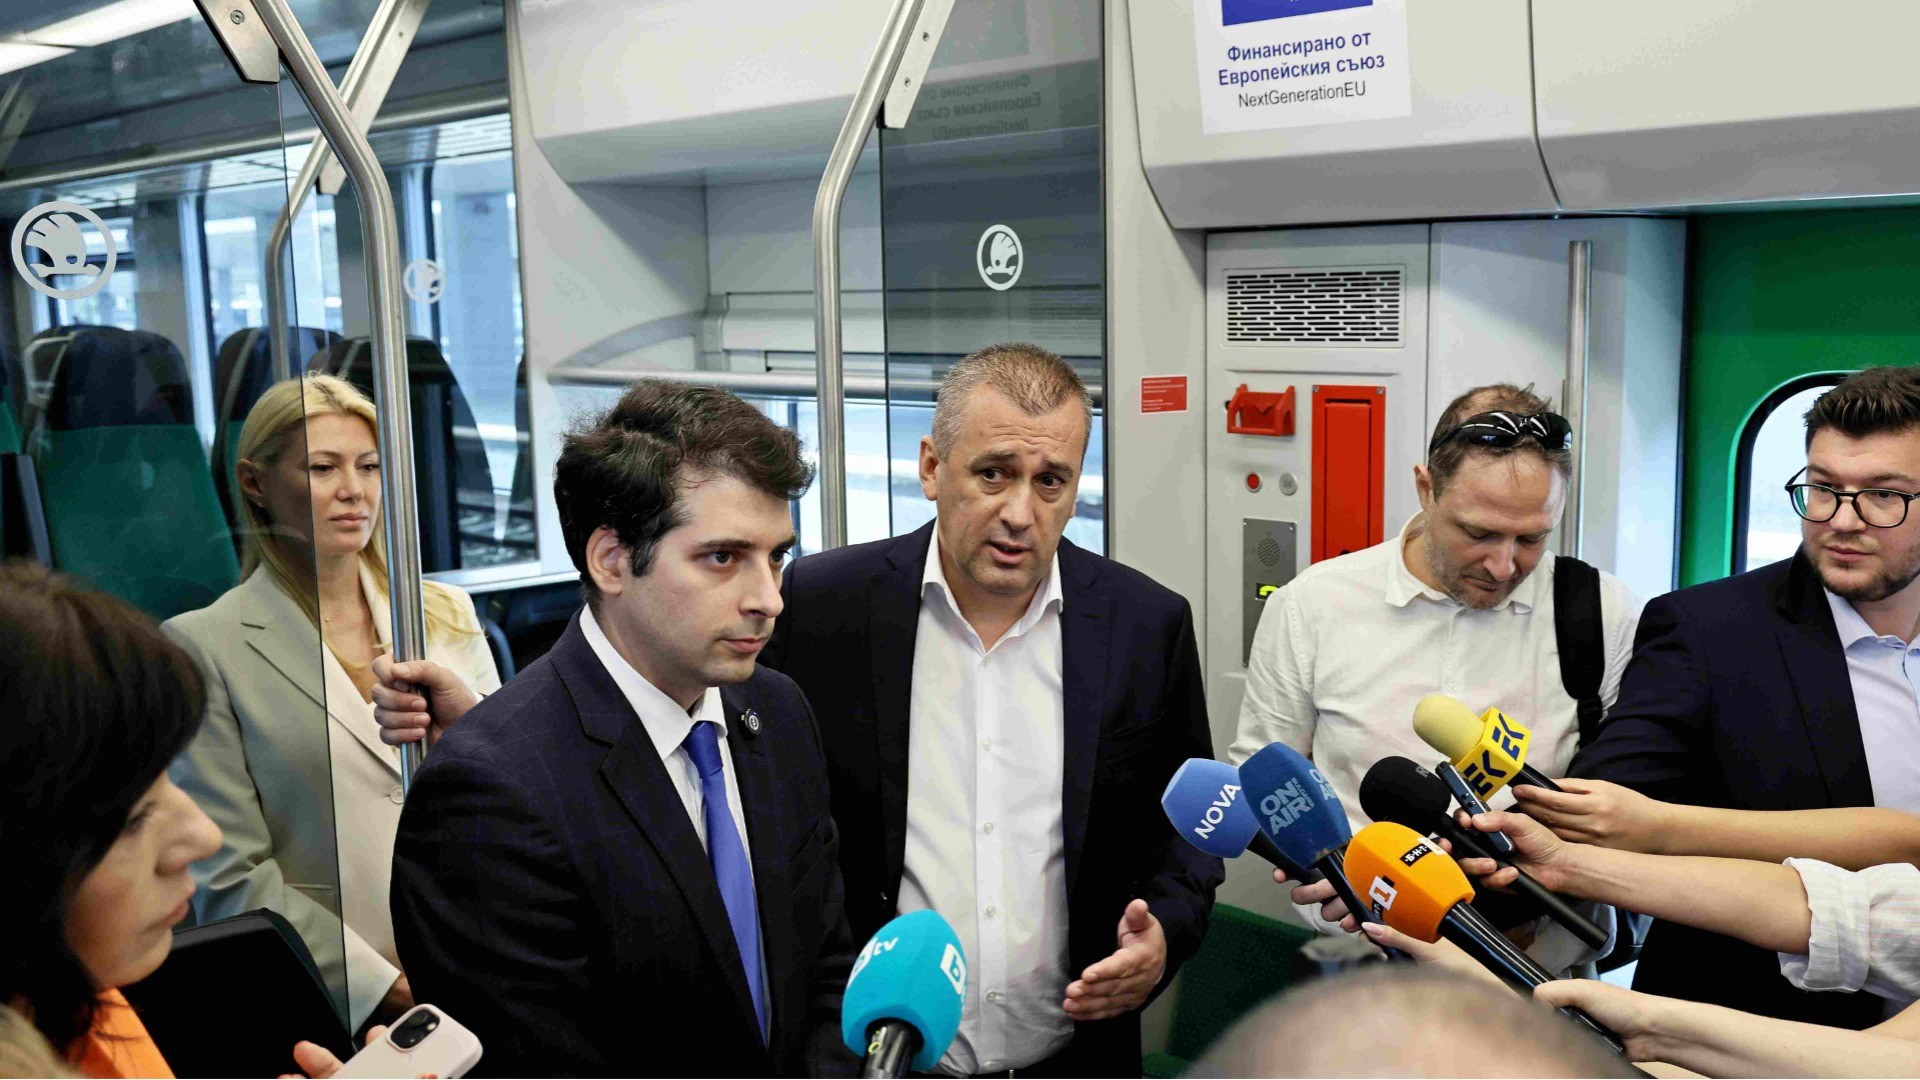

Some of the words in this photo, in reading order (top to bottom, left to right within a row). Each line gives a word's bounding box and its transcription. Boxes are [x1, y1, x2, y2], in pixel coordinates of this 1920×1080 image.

[1227, 36, 1346, 61] Финансирано
[1351, 32, 1372, 47] от
[1218, 61, 1330, 87] Европейския
[1336, 55, 1385, 72] съюз
[1238, 80, 1366, 107] NextGenerationEU
[1260, 780, 1300, 816] ON
[1290, 777, 1315, 808] BULGARIA
[1194, 783, 1242, 840] NOVA
[1269, 796, 1312, 836] AIR
[1373, 886, 1391, 903] 1
